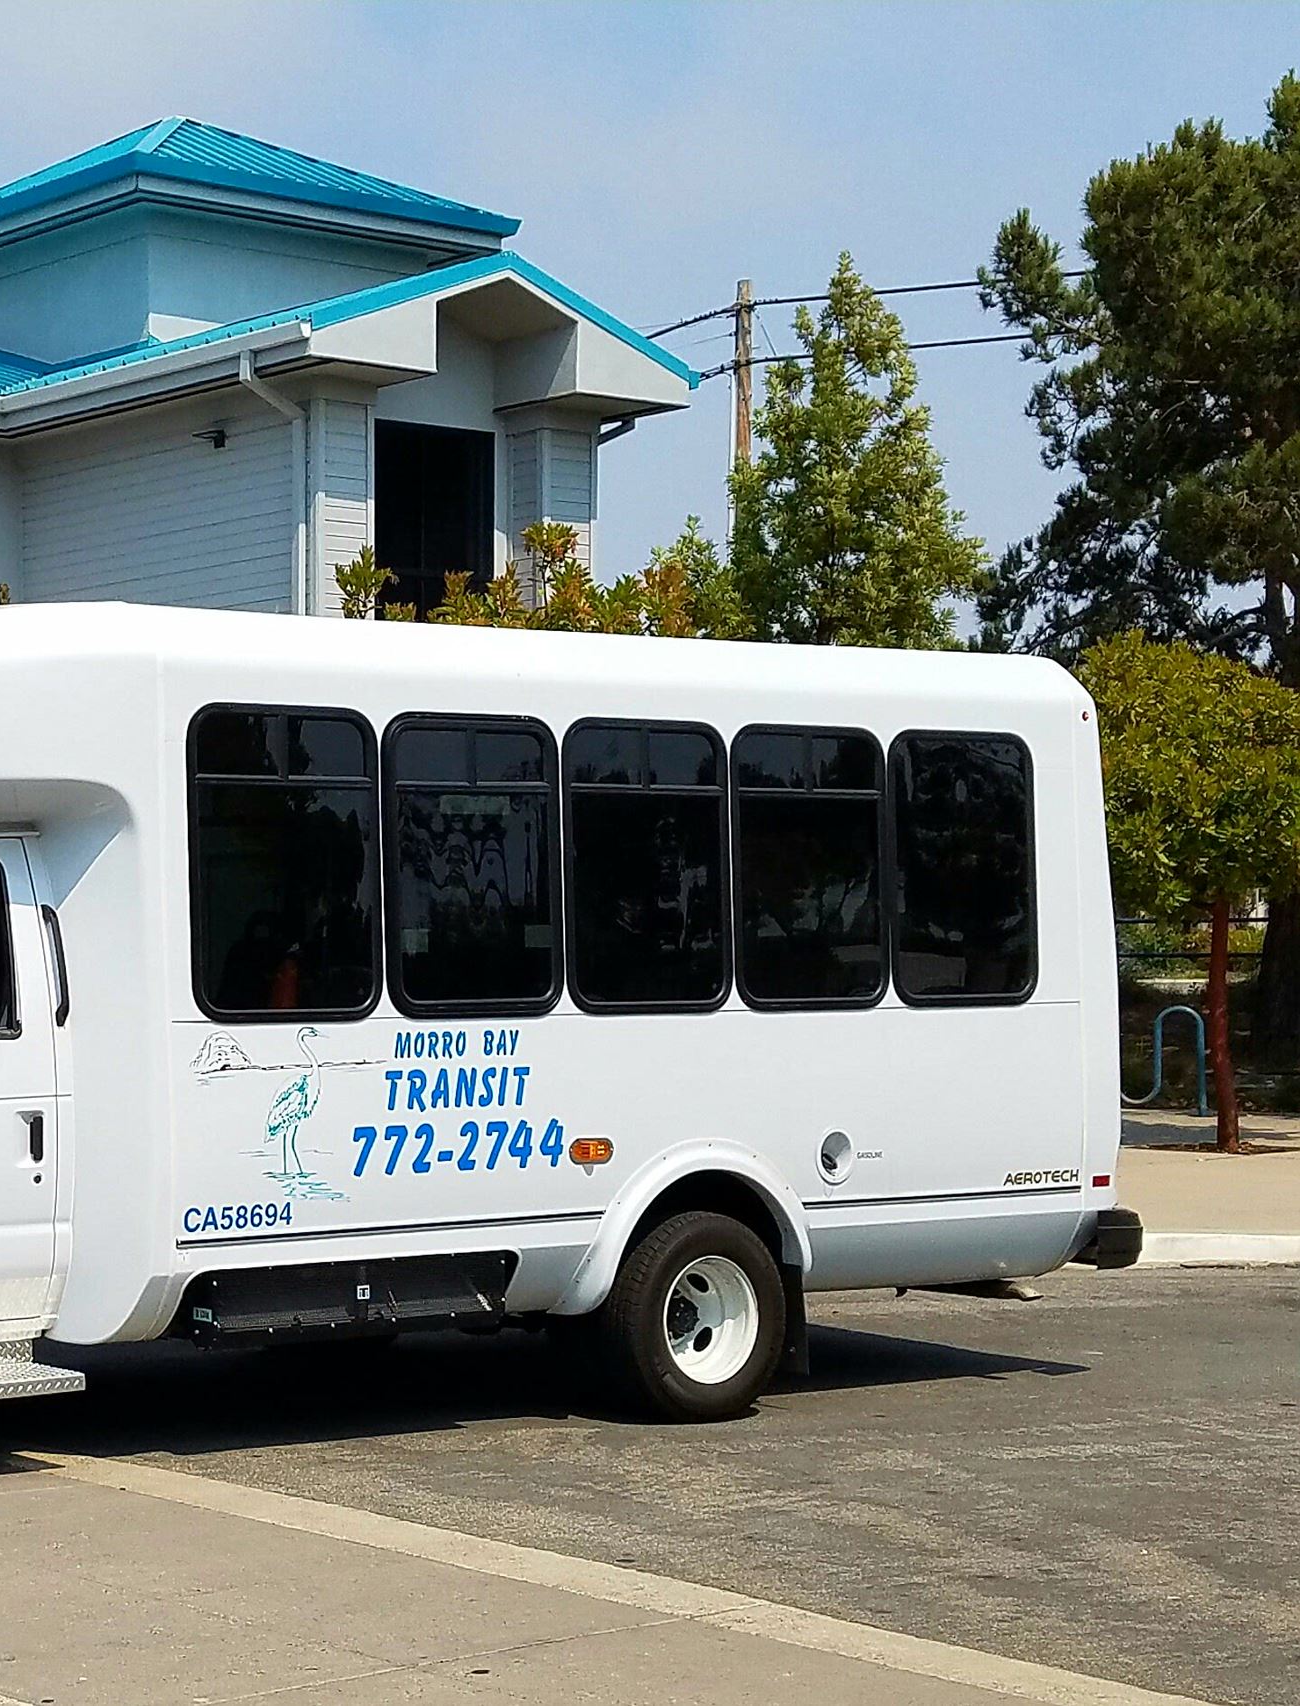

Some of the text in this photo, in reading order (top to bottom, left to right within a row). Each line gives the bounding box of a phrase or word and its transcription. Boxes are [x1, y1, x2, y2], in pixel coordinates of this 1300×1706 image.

[394, 1029, 520, 1060] MORRO BAY
[385, 1066, 530, 1112] TRANSIT
[352, 1118, 564, 1177] 772-2744
[1003, 1169, 1080, 1186] AEROTECH
[183, 1201, 293, 1233] CA58694
